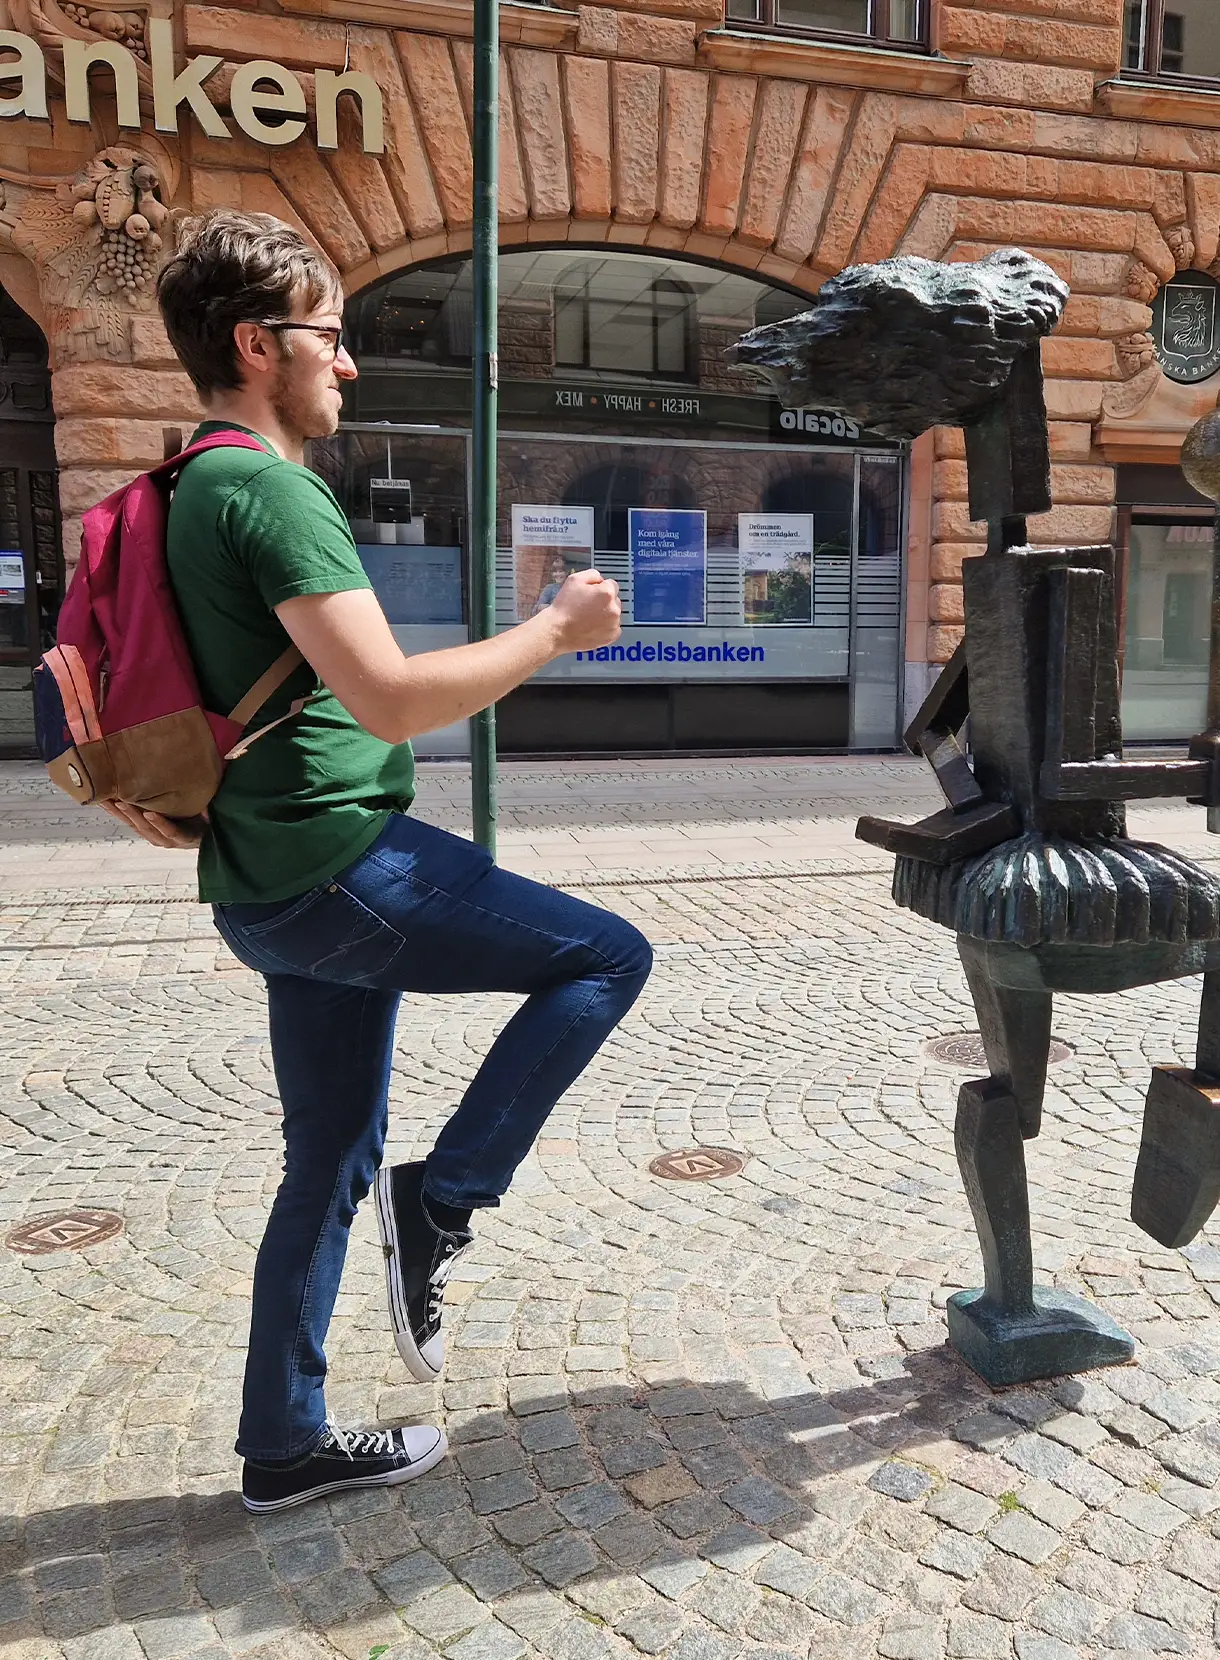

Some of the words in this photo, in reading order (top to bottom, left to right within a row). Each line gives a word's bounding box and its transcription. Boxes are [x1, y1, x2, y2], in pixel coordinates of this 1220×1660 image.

[0, 17, 384, 154] anken
[522, 515, 538, 524] Ska
[540, 516, 552, 524] du
[523, 525, 569, 533] hemifrån?
[637, 529, 657, 538] Kom
[658, 529, 680, 540] igång
[638, 539, 656, 547] med
[657, 540, 675, 548] våra
[637, 549, 667, 558] digitala
